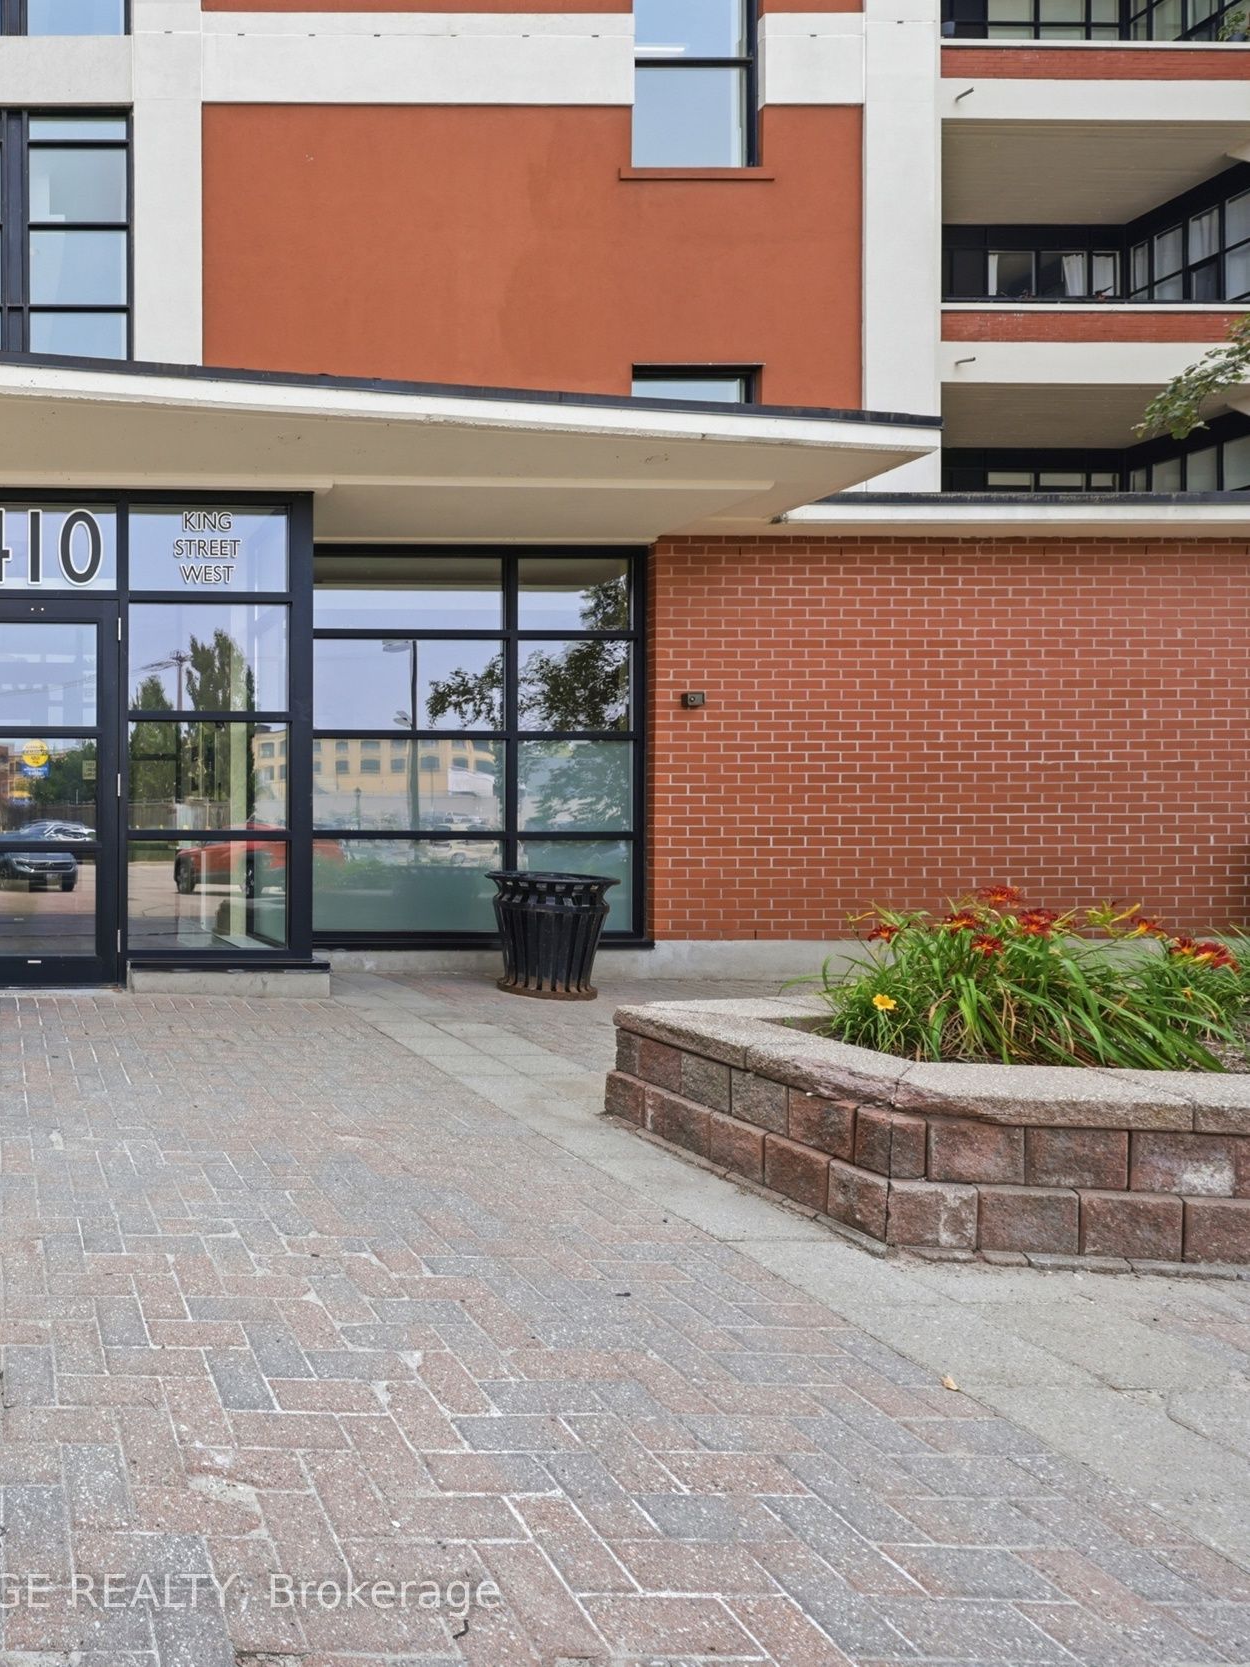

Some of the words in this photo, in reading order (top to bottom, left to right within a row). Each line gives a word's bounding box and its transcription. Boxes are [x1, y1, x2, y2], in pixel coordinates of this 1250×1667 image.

[183, 512, 233, 531] KING
[174, 538, 241, 557] STREET
[180, 564, 235, 583] WEST
